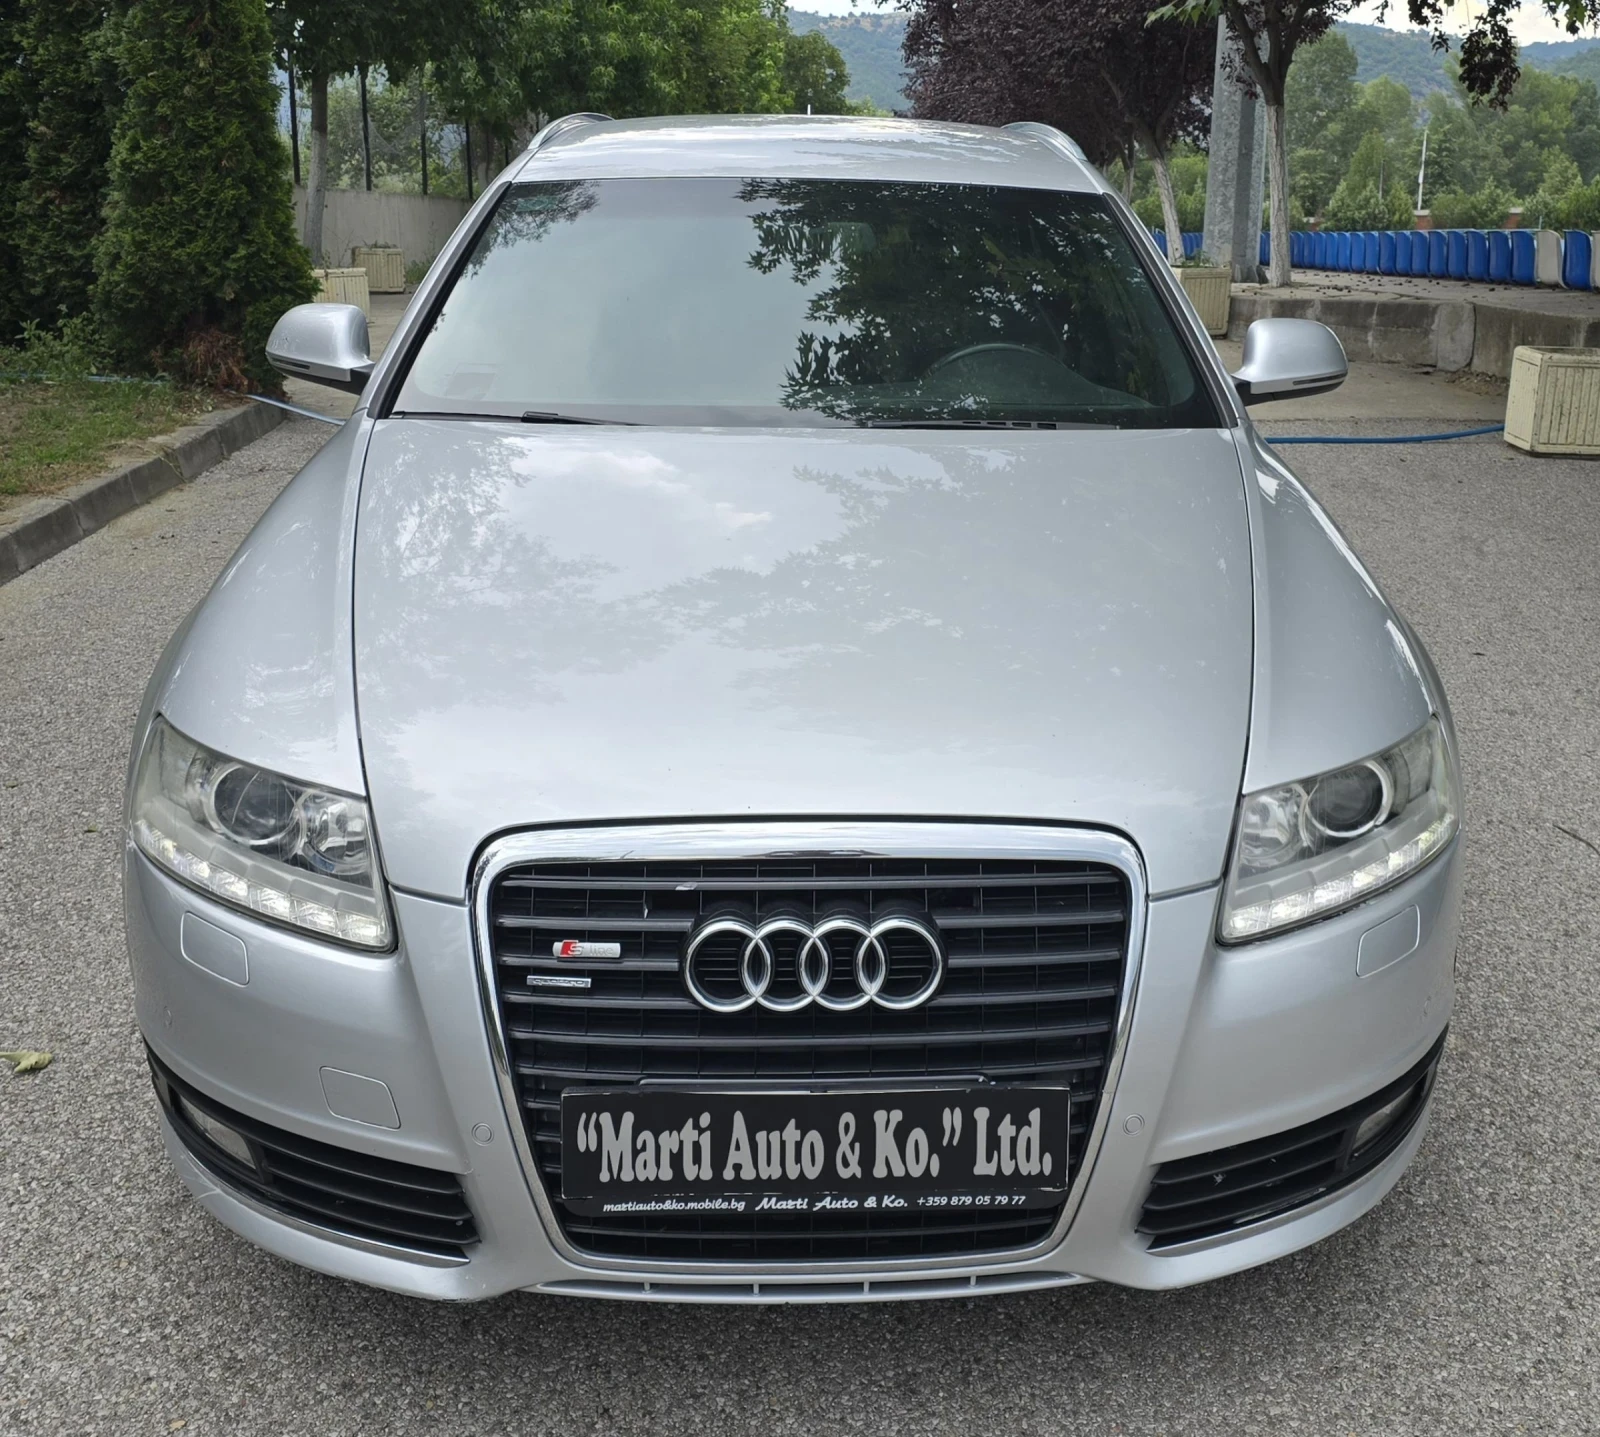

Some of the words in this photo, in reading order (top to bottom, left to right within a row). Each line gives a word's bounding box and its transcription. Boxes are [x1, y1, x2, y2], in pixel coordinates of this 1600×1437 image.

[565, 942, 584, 957] S
[723, 1110, 825, 1180] Auto
[836, 1112, 861, 1179] &
[973, 1107, 1052, 1176] Ltd.
[603, 1198, 746, 1212] martiauto&ko.mobile.bg
[755, 1197, 808, 1211] Marti
[812, 1196, 859, 1211] Auto
[864, 1196, 877, 1208] &
[881, 1195, 908, 1208] Ko.
[916, 1196, 948, 1206] +359
[950, 1195, 972, 1206] 879
[975, 1195, 991, 1206] 05
[994, 1195, 1008, 1205] 79
[1011, 1195, 1026, 1205] 77
